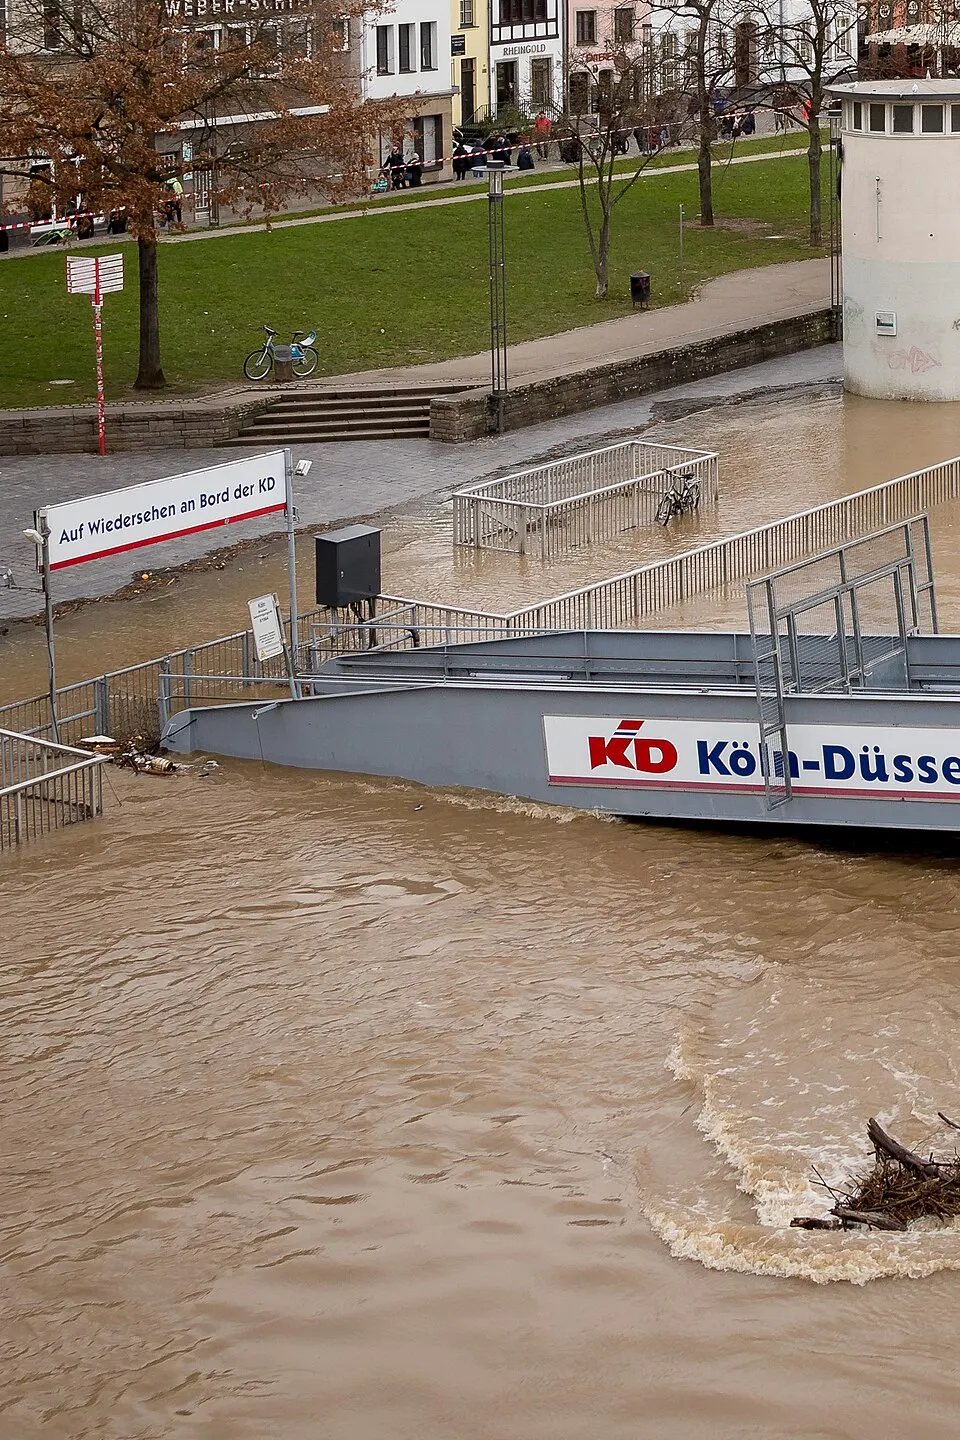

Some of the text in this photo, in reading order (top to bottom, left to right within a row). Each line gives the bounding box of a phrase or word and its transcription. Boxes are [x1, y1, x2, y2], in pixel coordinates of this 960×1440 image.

[503, 43, 546, 56] RHEINGOLD
[59, 476, 275, 545] Auf Wiedersehen an Bord der KD
[588, 720, 678, 774] KD
